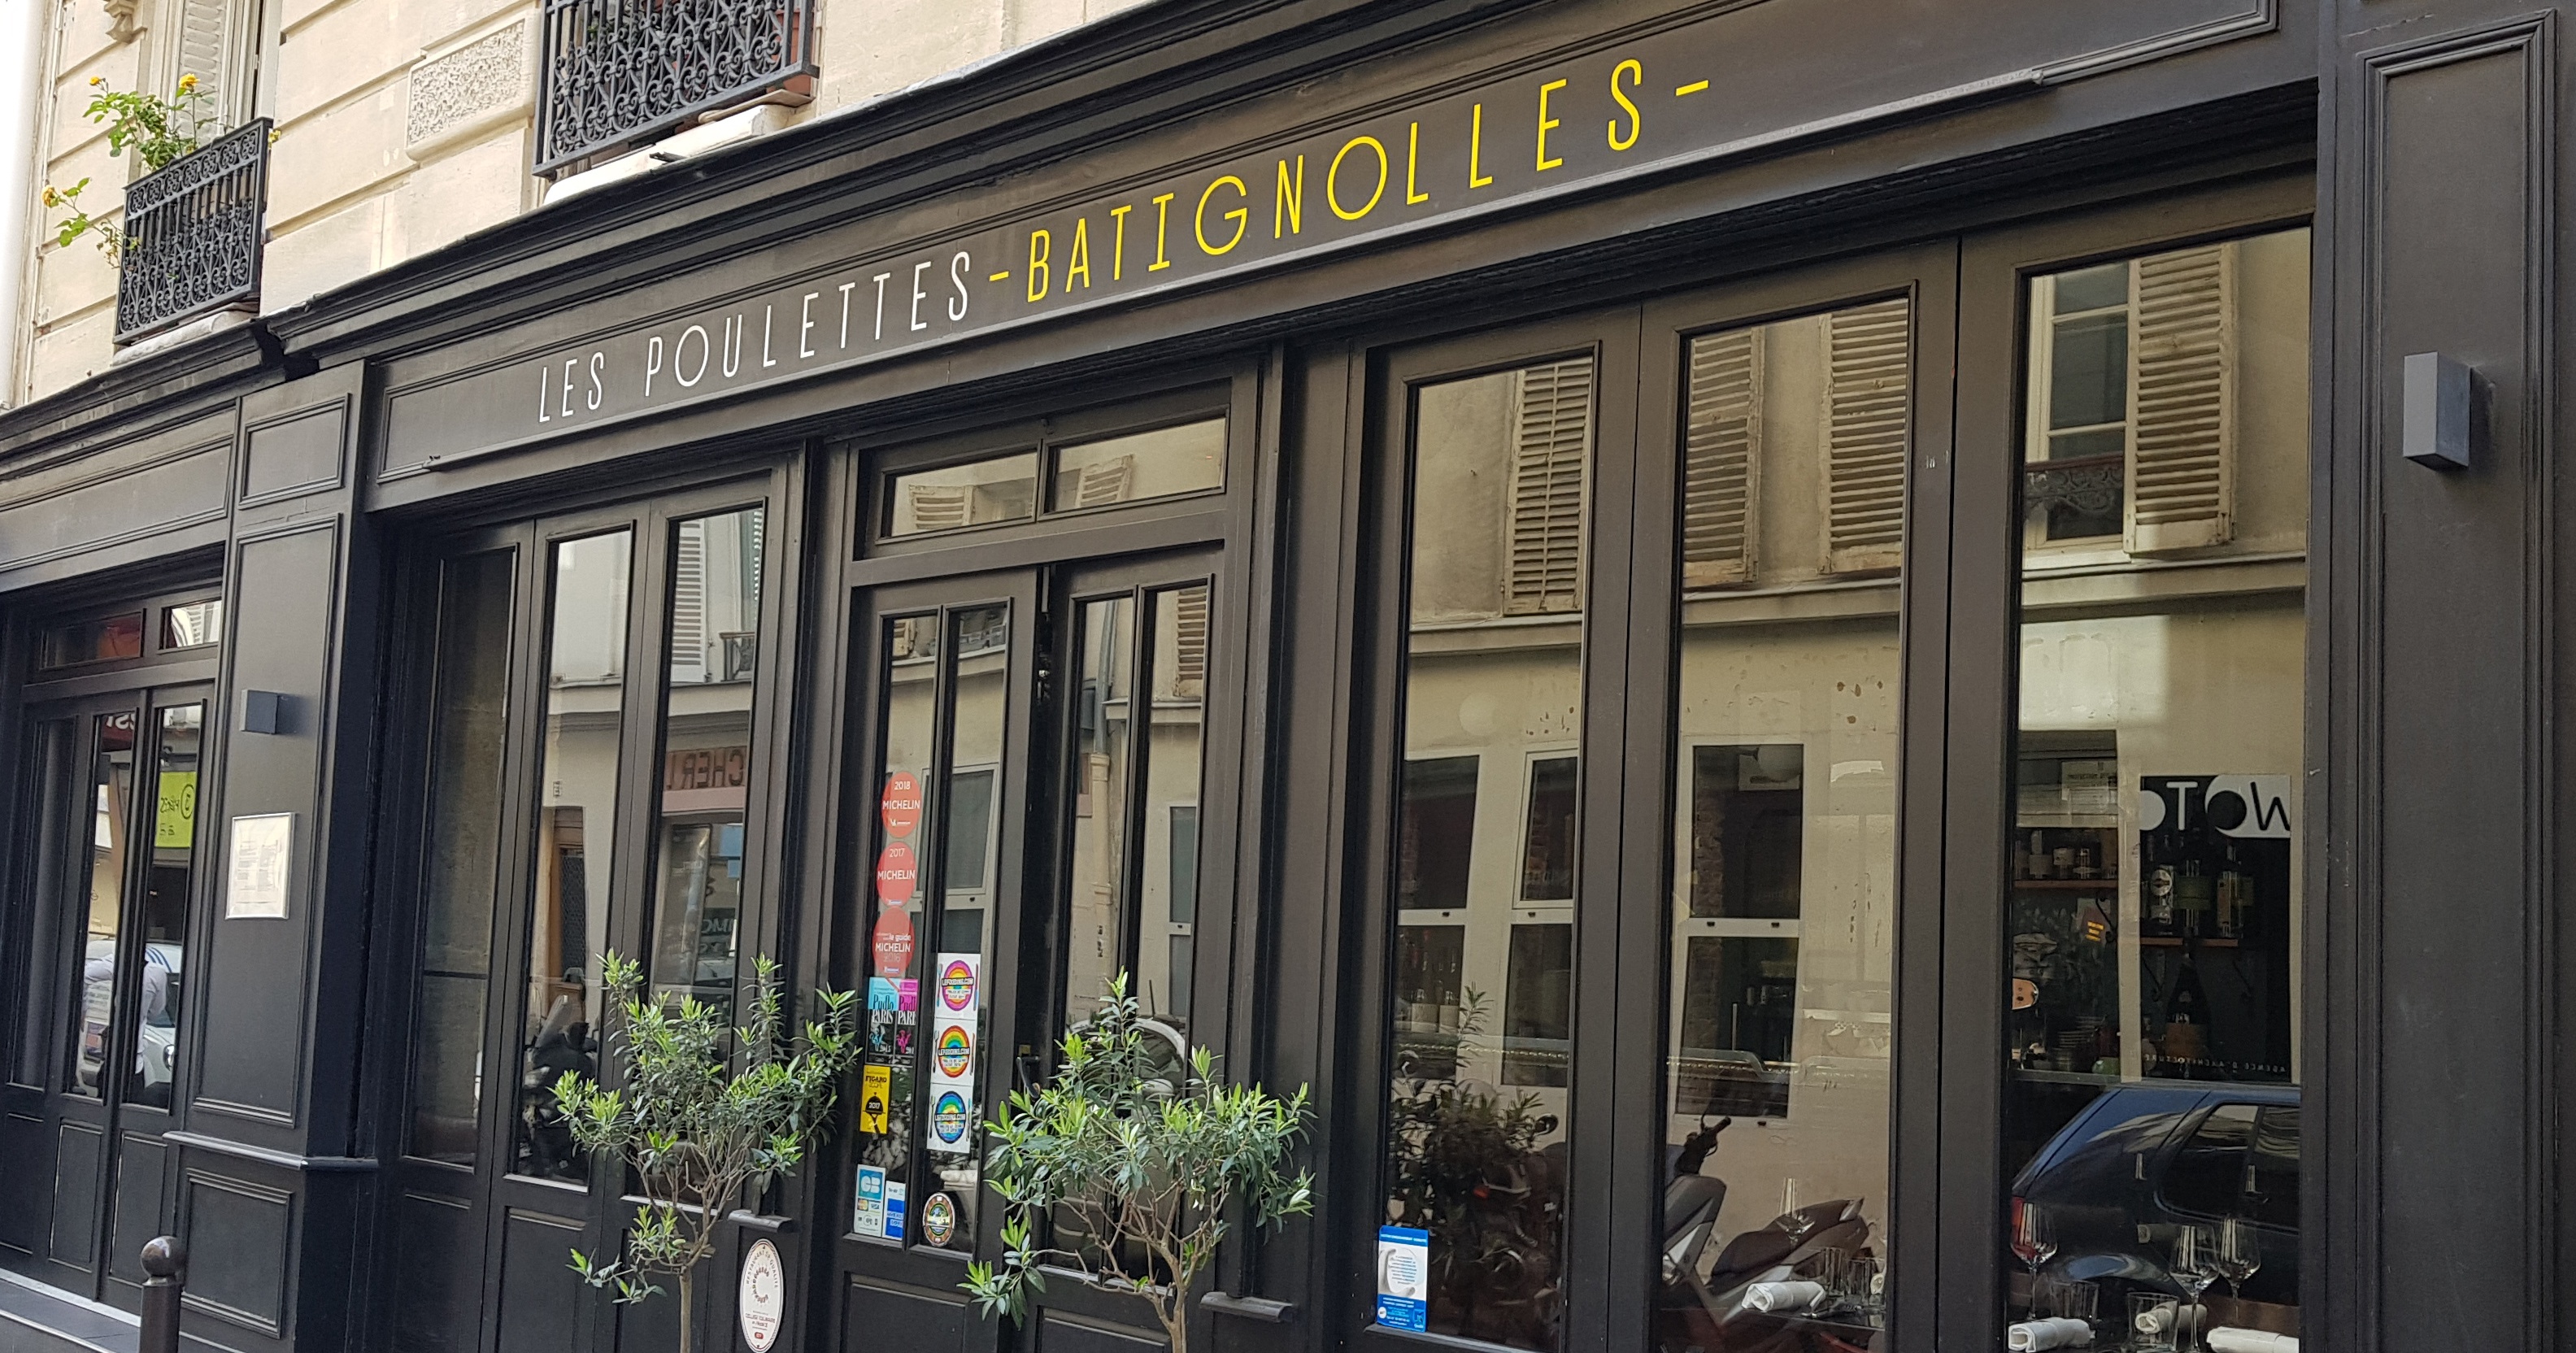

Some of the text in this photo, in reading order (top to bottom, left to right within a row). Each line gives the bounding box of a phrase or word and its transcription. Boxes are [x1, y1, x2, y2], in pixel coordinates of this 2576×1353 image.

[539, 351, 604, 423] LES
[894, 781, 911, 790] 2018
[882, 799, 920, 810] MICHELIN
[890, 848, 905, 858] 2017
[877, 869, 916, 881] MICHELIN
[875, 942, 911, 953] MICHELIN
[872, 1009, 894, 1024] PARIS
